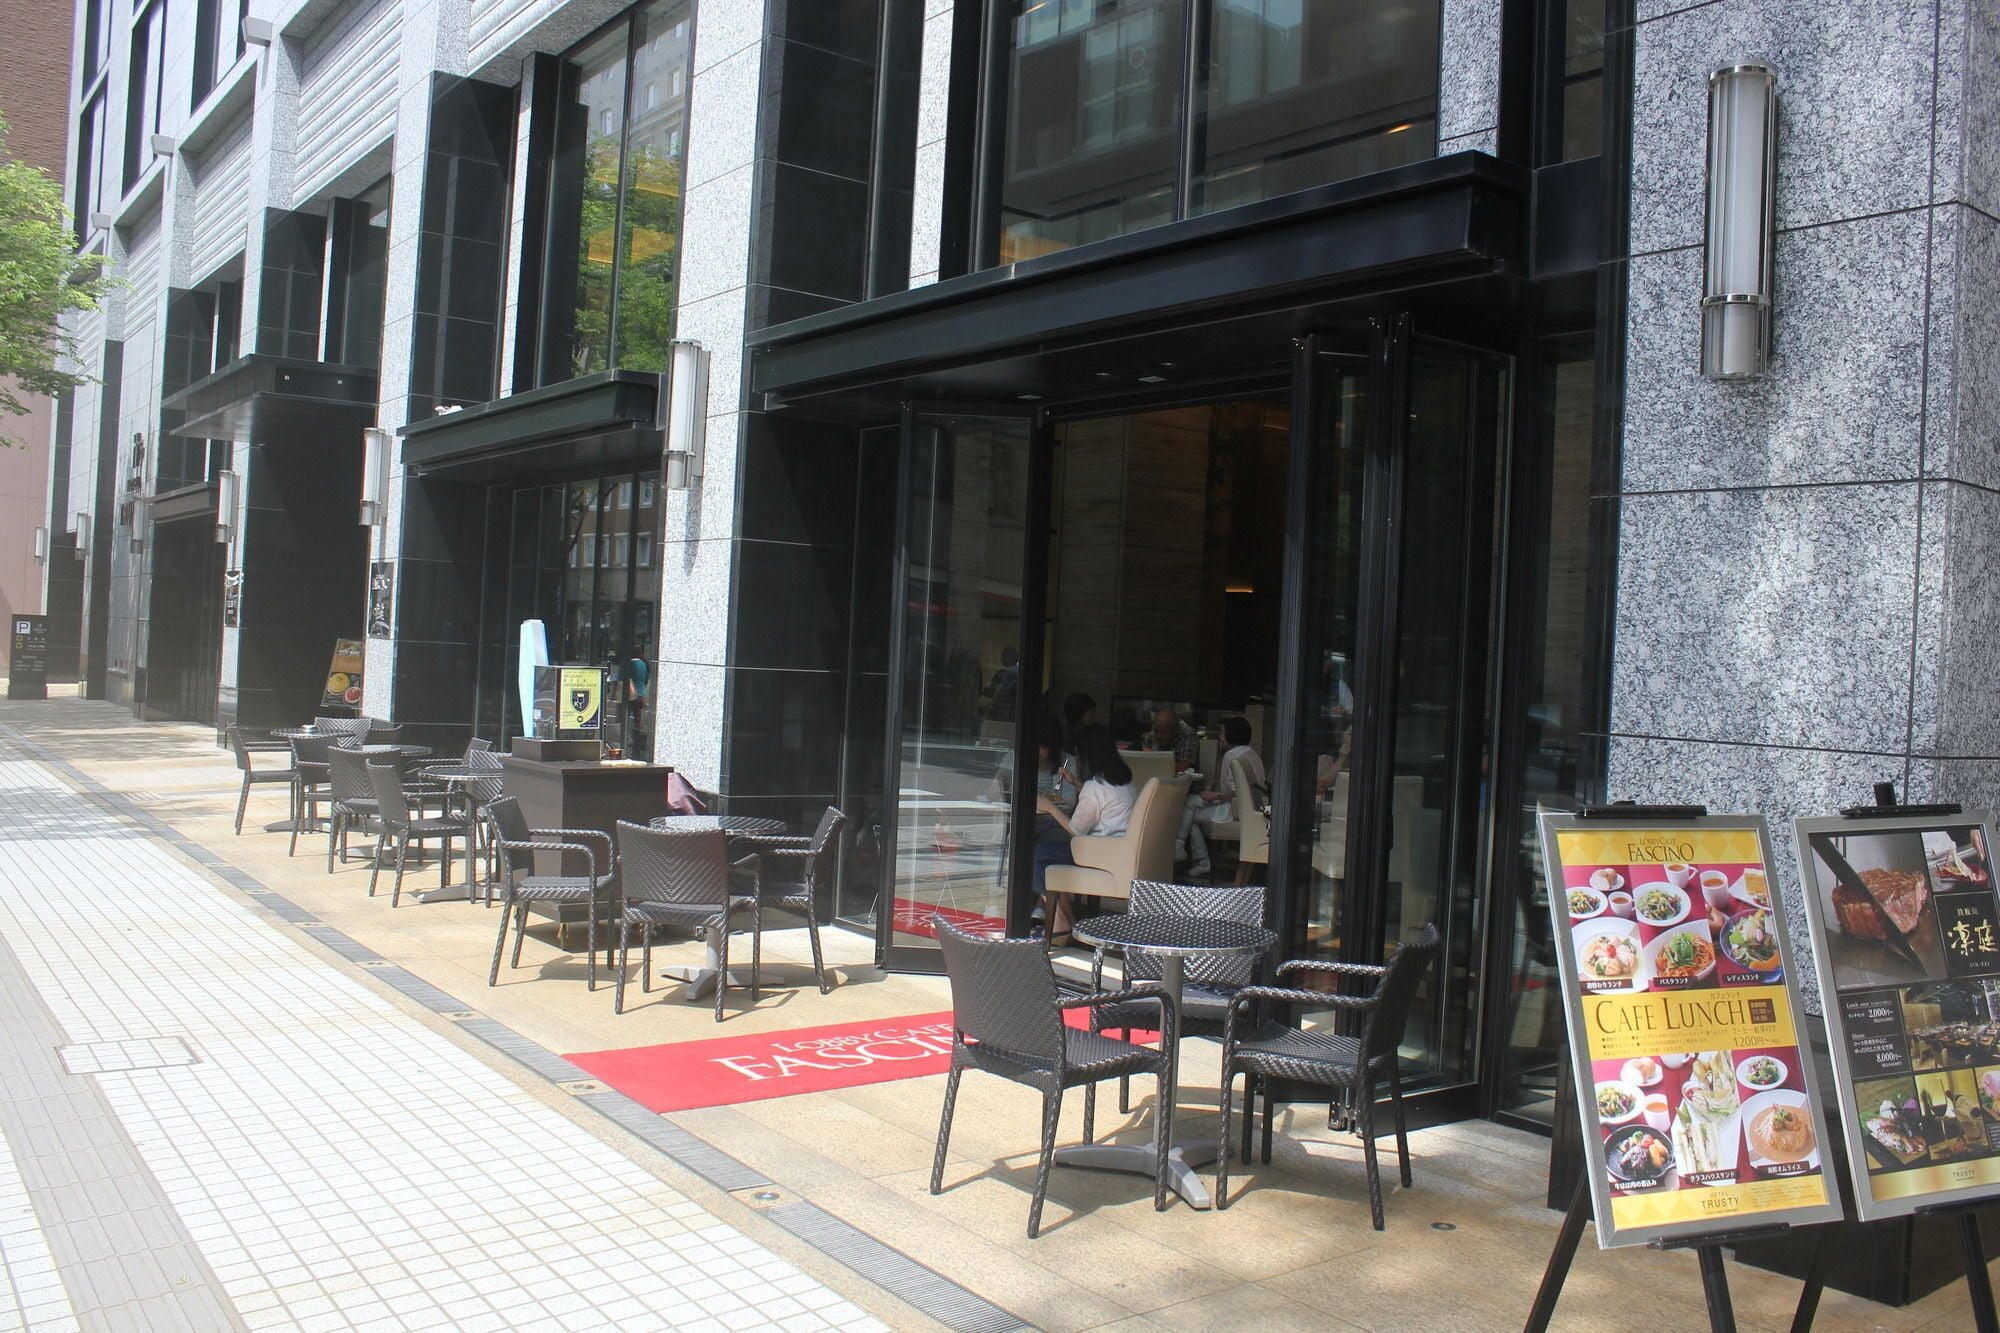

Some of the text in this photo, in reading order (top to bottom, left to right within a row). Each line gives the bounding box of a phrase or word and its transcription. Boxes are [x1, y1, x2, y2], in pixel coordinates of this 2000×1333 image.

[1627, 843, 1695, 862] FASCINO
[1726, 974, 1760, 982] レディスランチ
[1595, 997, 1745, 1034] CAFE LUNCH
[1701, 1197, 1739, 1209] TRUSTY
